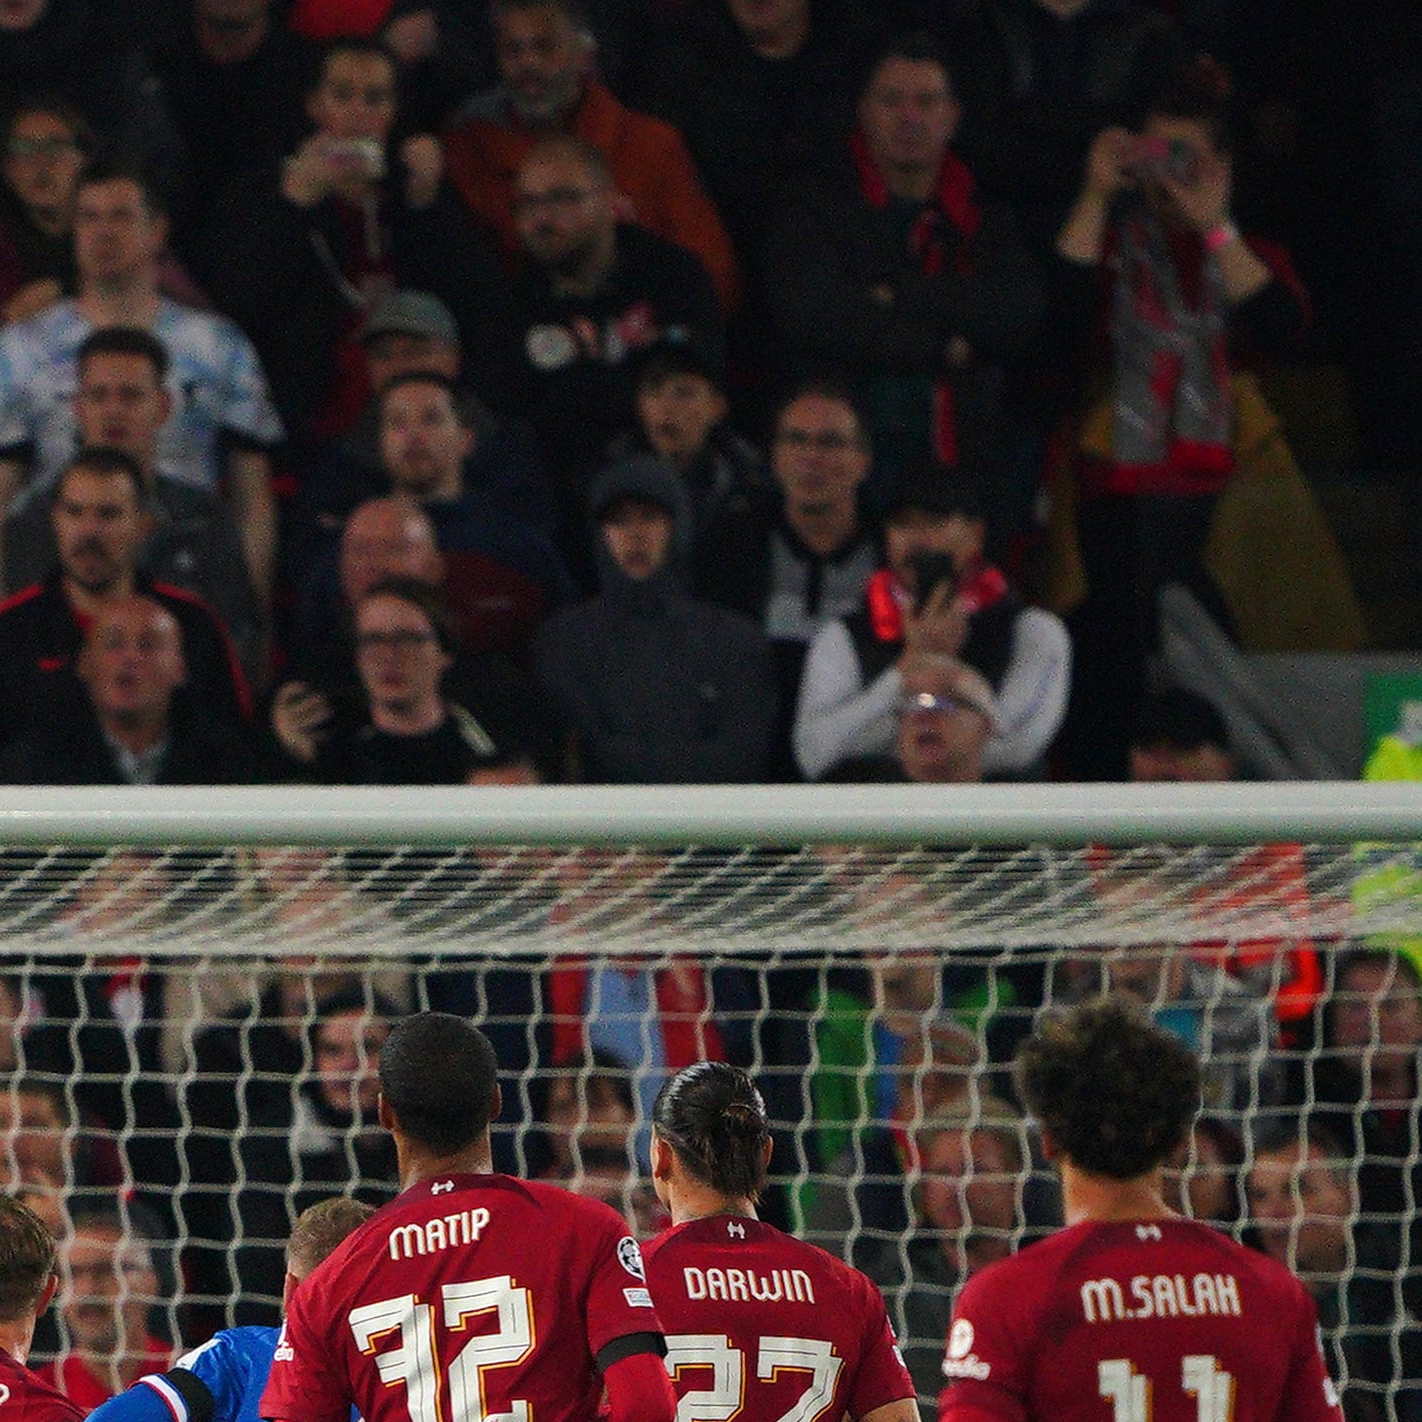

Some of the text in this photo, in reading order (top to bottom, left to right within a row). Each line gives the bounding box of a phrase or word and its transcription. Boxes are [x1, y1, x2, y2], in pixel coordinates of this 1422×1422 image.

[389, 1207, 490, 1261] MATIP
[683, 1266, 815, 1304] DARWIN
[1081, 1273, 1242, 1323] M.SALAH
